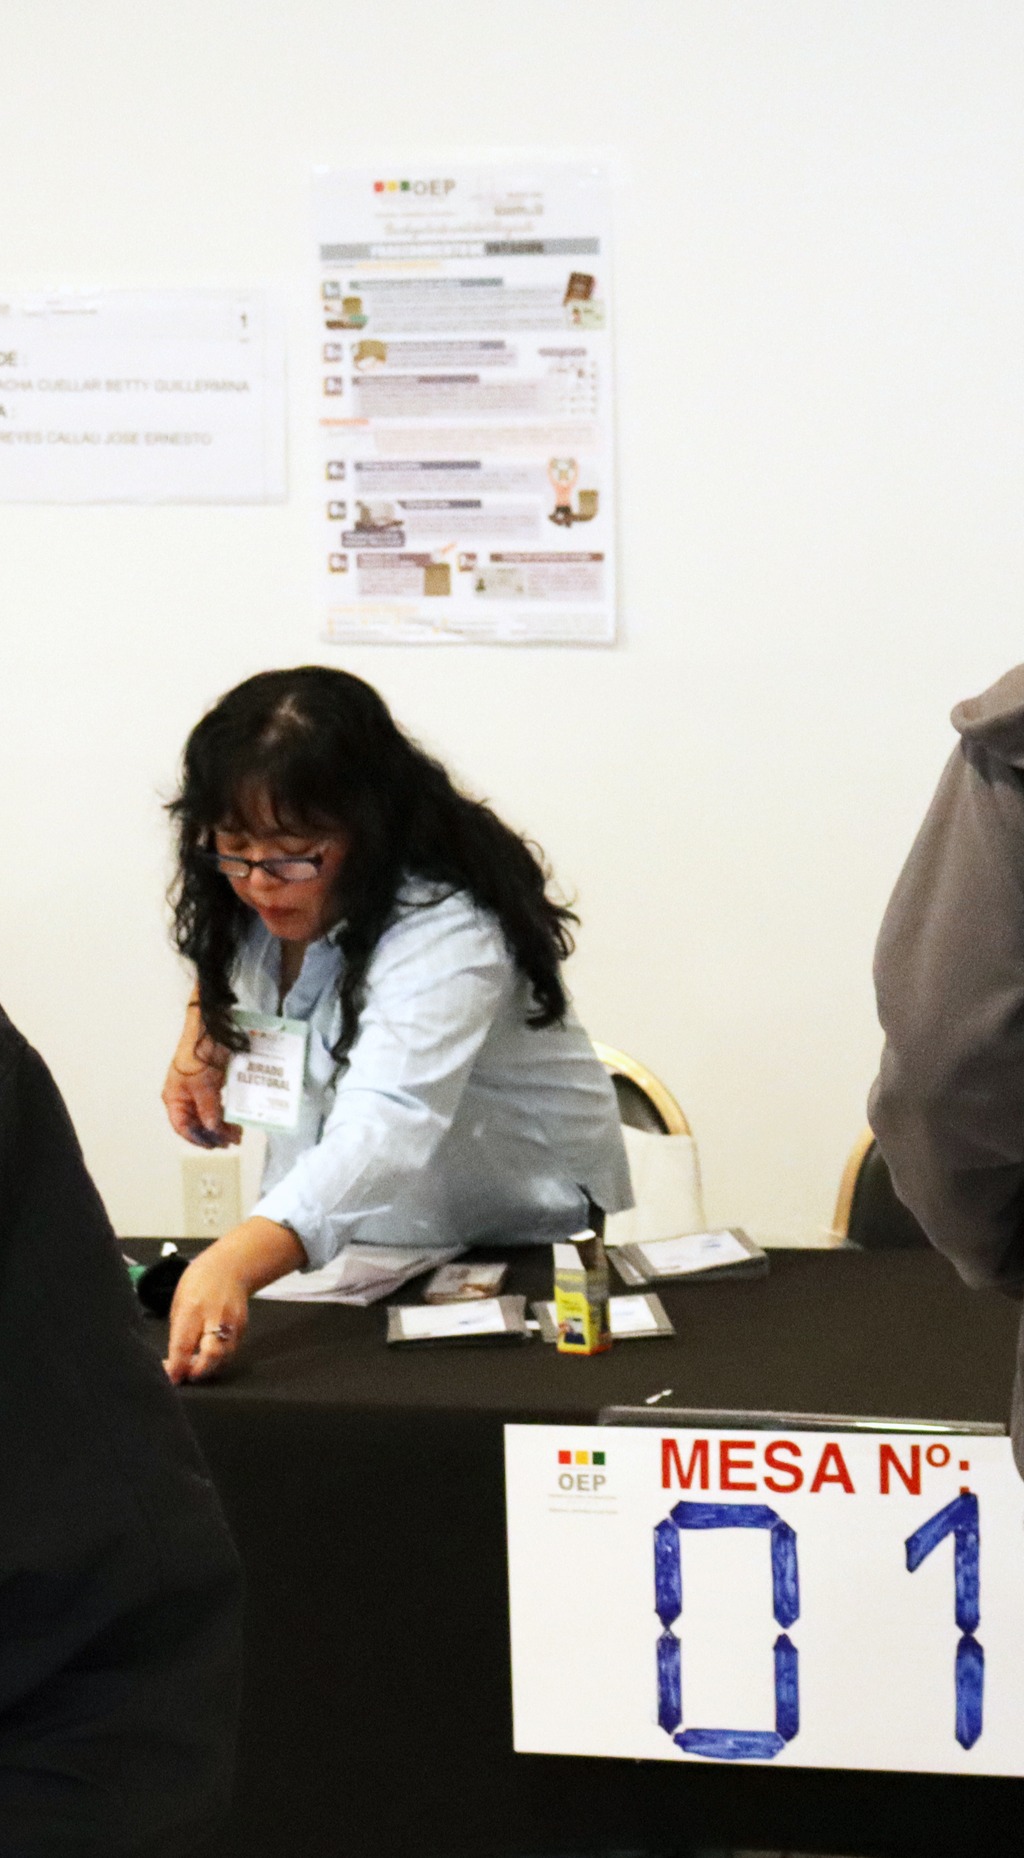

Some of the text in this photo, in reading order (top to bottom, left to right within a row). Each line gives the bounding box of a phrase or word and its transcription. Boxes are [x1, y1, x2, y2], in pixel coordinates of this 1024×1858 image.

[413, 179, 456, 196] OEP
[105, 378, 149, 392] BETTY
[144, 432, 213, 446] ERNESTO
[237, 1071, 291, 1091] ELECTORAL
[660, 1438, 856, 1495] MESA
[557, 1473, 607, 1492] OEP
